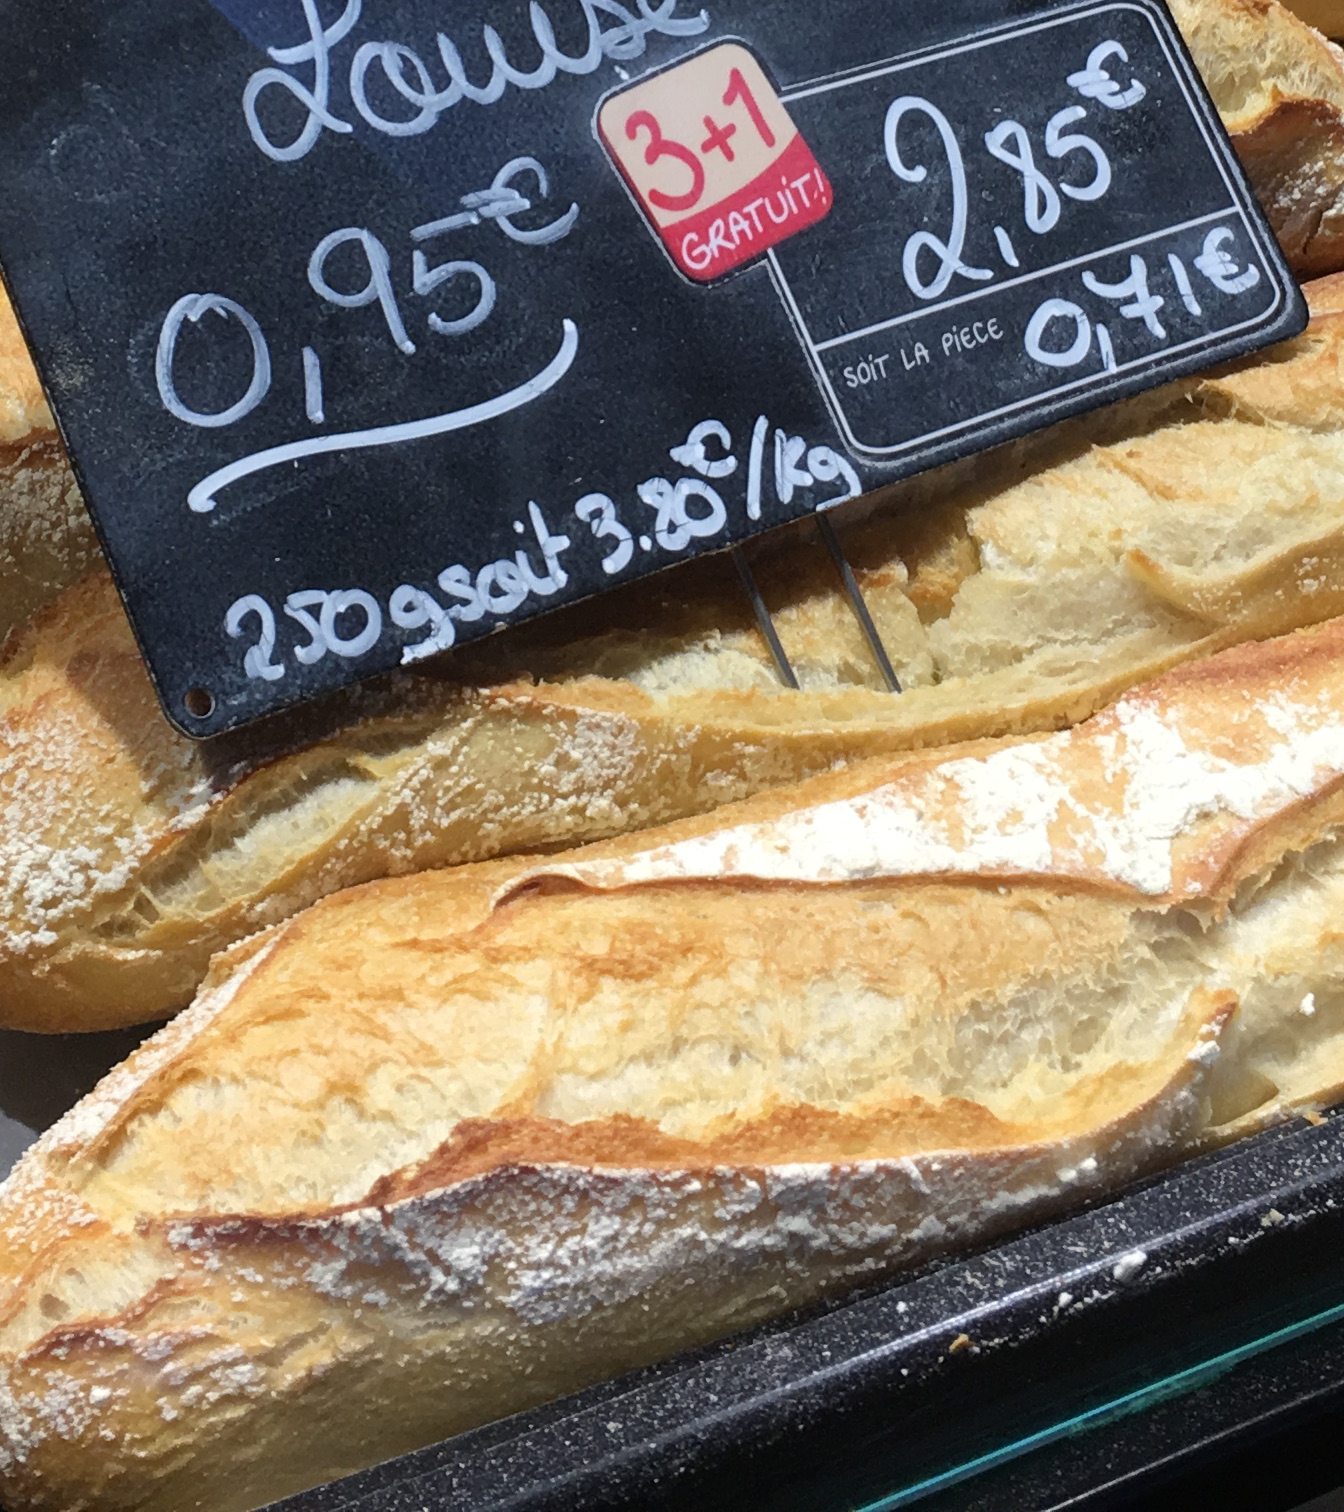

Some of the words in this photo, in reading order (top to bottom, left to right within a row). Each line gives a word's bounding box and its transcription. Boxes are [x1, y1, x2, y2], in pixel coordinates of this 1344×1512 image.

[625, 67, 776, 213] 3+1
[883, 39, 1147, 300] 2,85€
[679, 166, 827, 272] GRATUIT!
[843, 352, 889, 389] SOIT
[899, 341, 931, 371] LA
[940, 316, 1005, 357] PIECE
[1024, 226, 1261, 374] 0,71€
